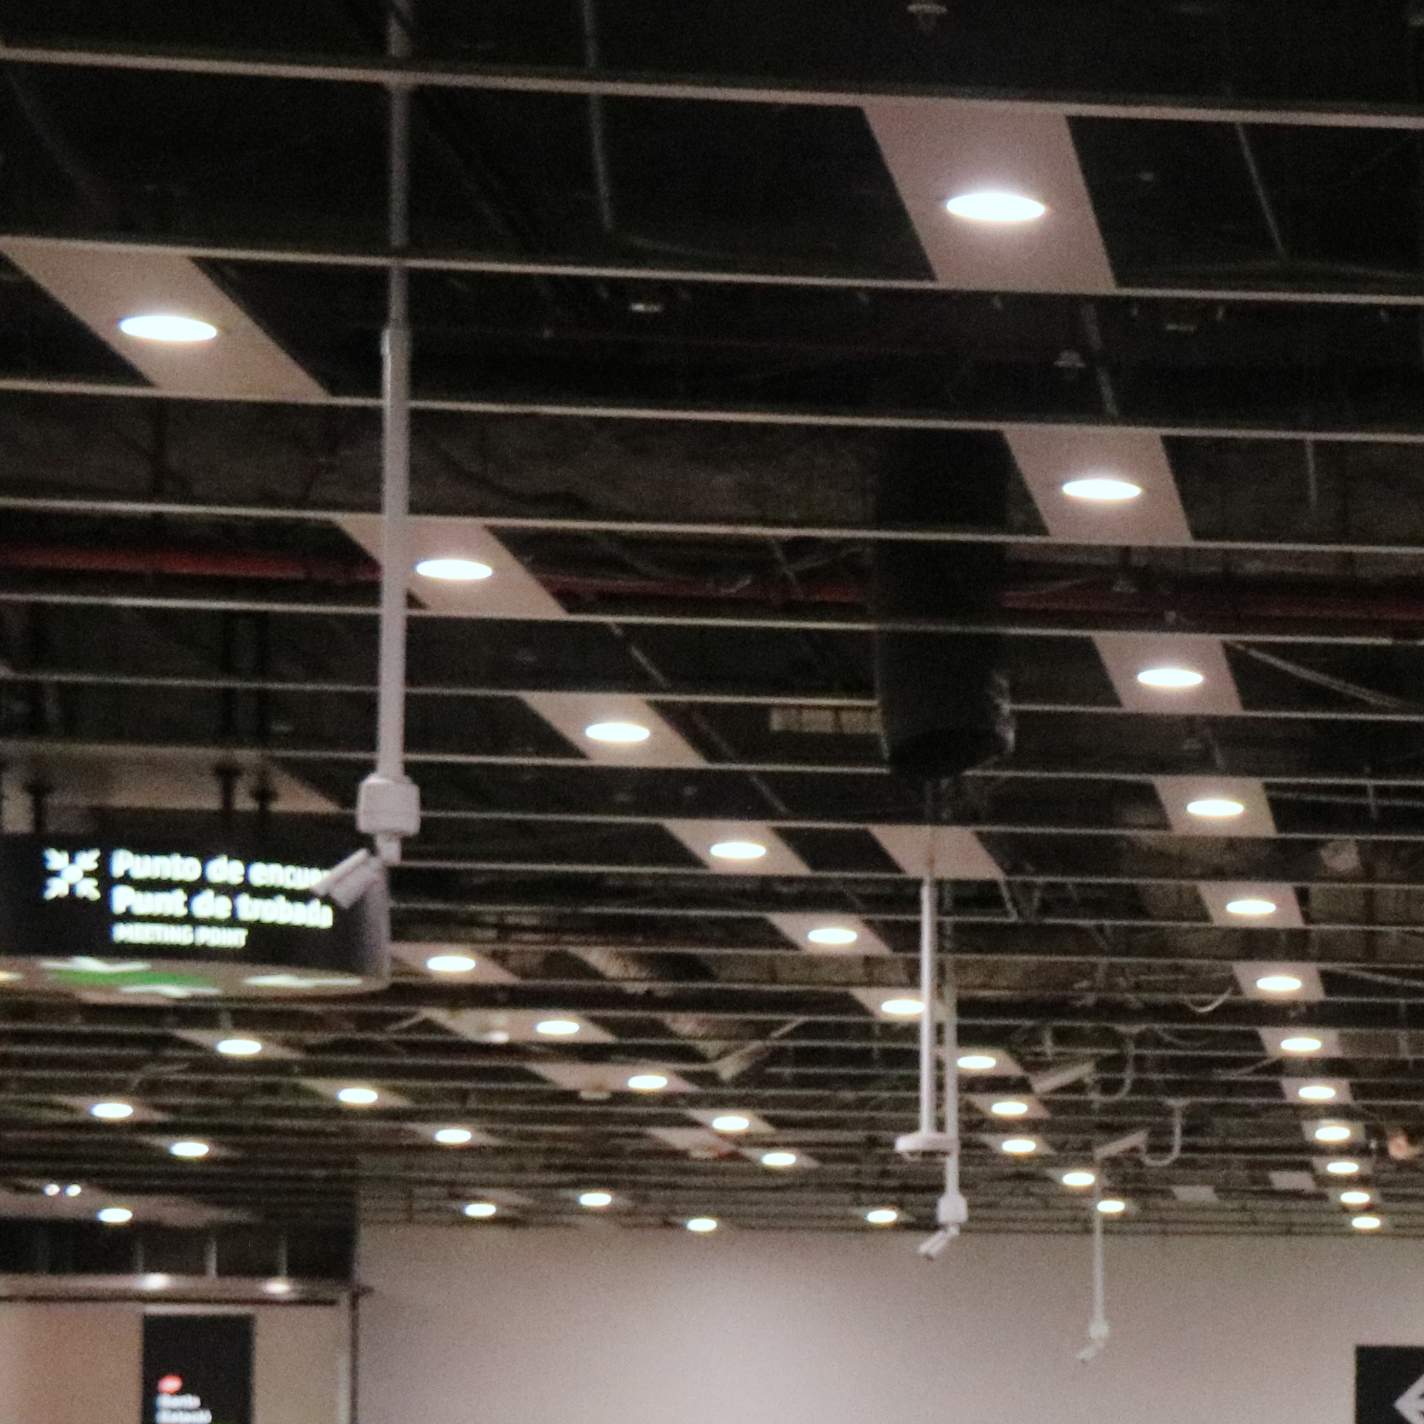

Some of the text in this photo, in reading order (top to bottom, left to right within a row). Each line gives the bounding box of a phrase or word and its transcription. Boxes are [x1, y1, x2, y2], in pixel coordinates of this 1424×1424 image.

[112, 849, 330, 890] Punto de encue
[112, 885, 188, 916] Punt
[191, 889, 233, 919] de
